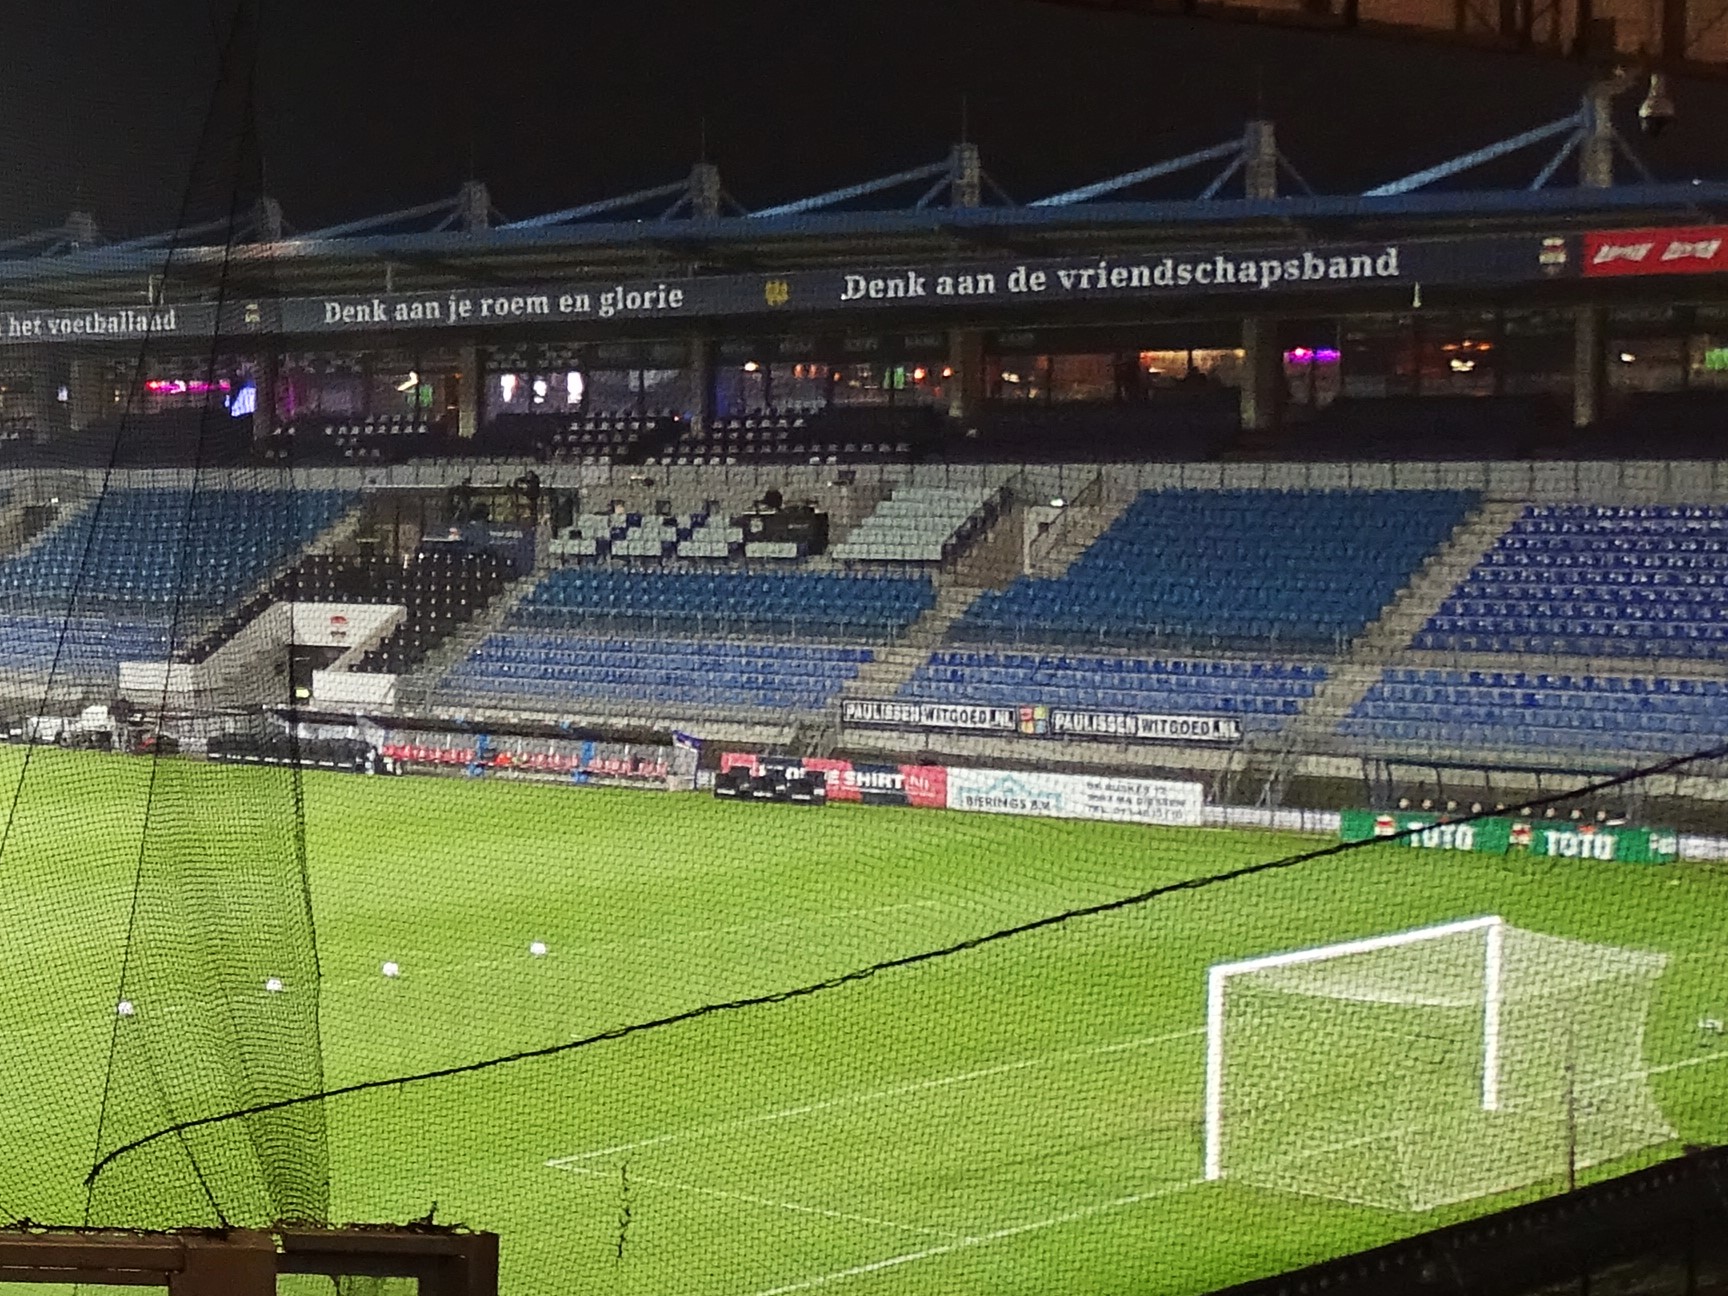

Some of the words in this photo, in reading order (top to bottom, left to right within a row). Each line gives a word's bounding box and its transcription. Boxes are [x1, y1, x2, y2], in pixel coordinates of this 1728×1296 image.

[842, 271, 926, 300] Denk
[936, 273, 996, 296] aan
[1007, 266, 1047, 292] de
[1058, 247, 1399, 289] vriendschapsband
[323, 298, 387, 324] Denk
[394, 299, 440, 321] aan
[446, 293, 473, 324] je
[481, 294, 550, 317] roem
[559, 293, 591, 314] en
[598, 284, 684, 317] glorie
[8, 316, 42, 338] het
[47, 309, 176, 335] voetballand
[965, 796, 1027, 811] BIERINGS
[1545, 830, 1616, 860] TOTO
